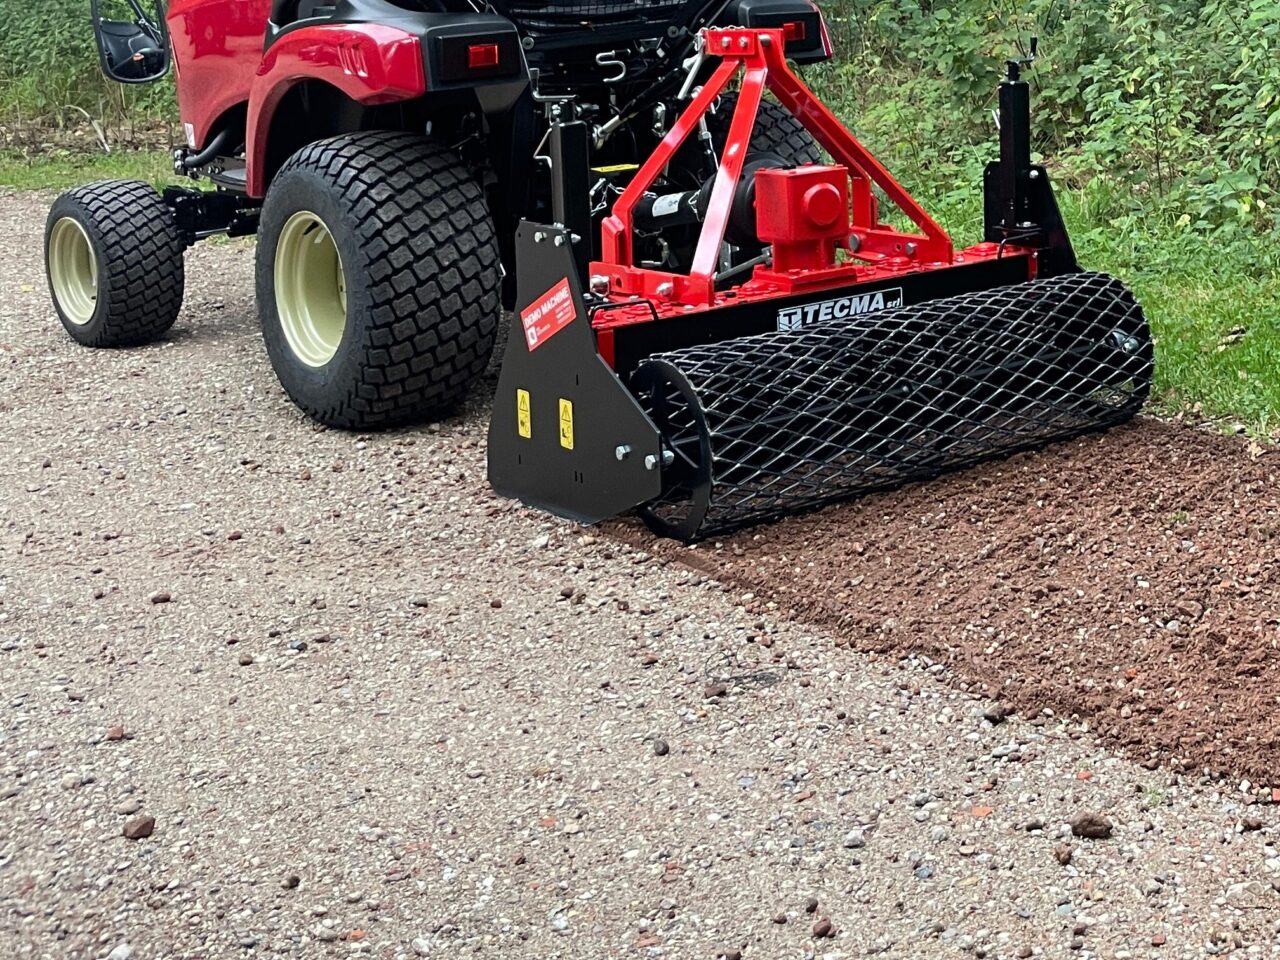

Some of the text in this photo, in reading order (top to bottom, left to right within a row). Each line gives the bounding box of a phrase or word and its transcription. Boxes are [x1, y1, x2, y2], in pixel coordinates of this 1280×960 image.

[524, 308, 542, 328] DEMO
[541, 286, 569, 315] MACHINE
[804, 293, 885, 324] TECMA
